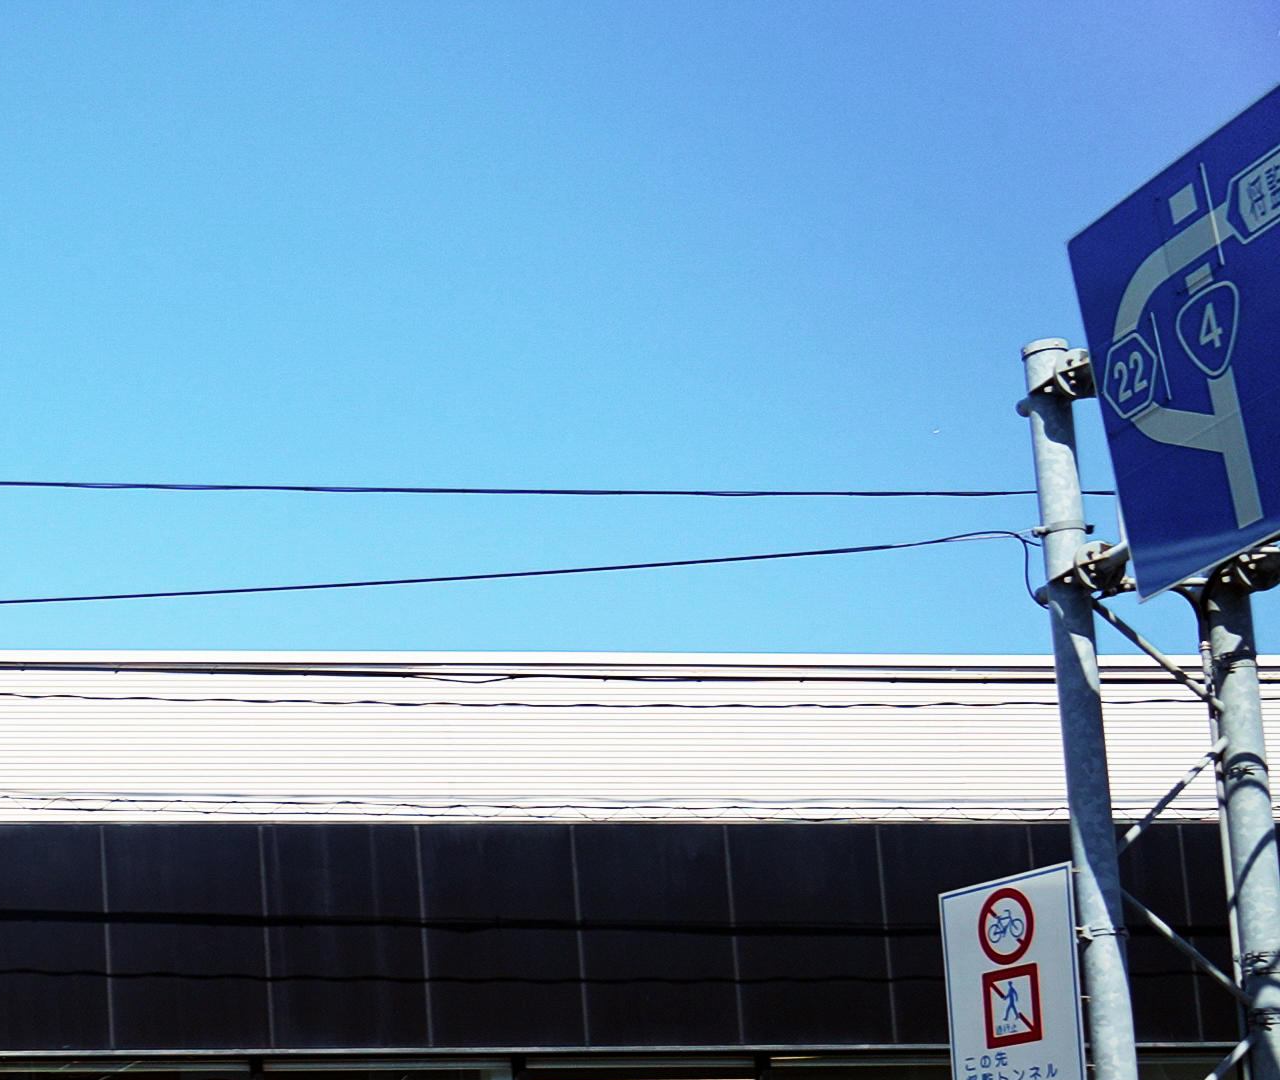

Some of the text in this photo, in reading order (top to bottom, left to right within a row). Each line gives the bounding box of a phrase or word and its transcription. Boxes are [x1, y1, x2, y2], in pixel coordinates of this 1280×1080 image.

[1200, 302, 1222, 348] 4
[1113, 351, 1148, 403] 22
[965, 1052, 1008, 1071] この先
